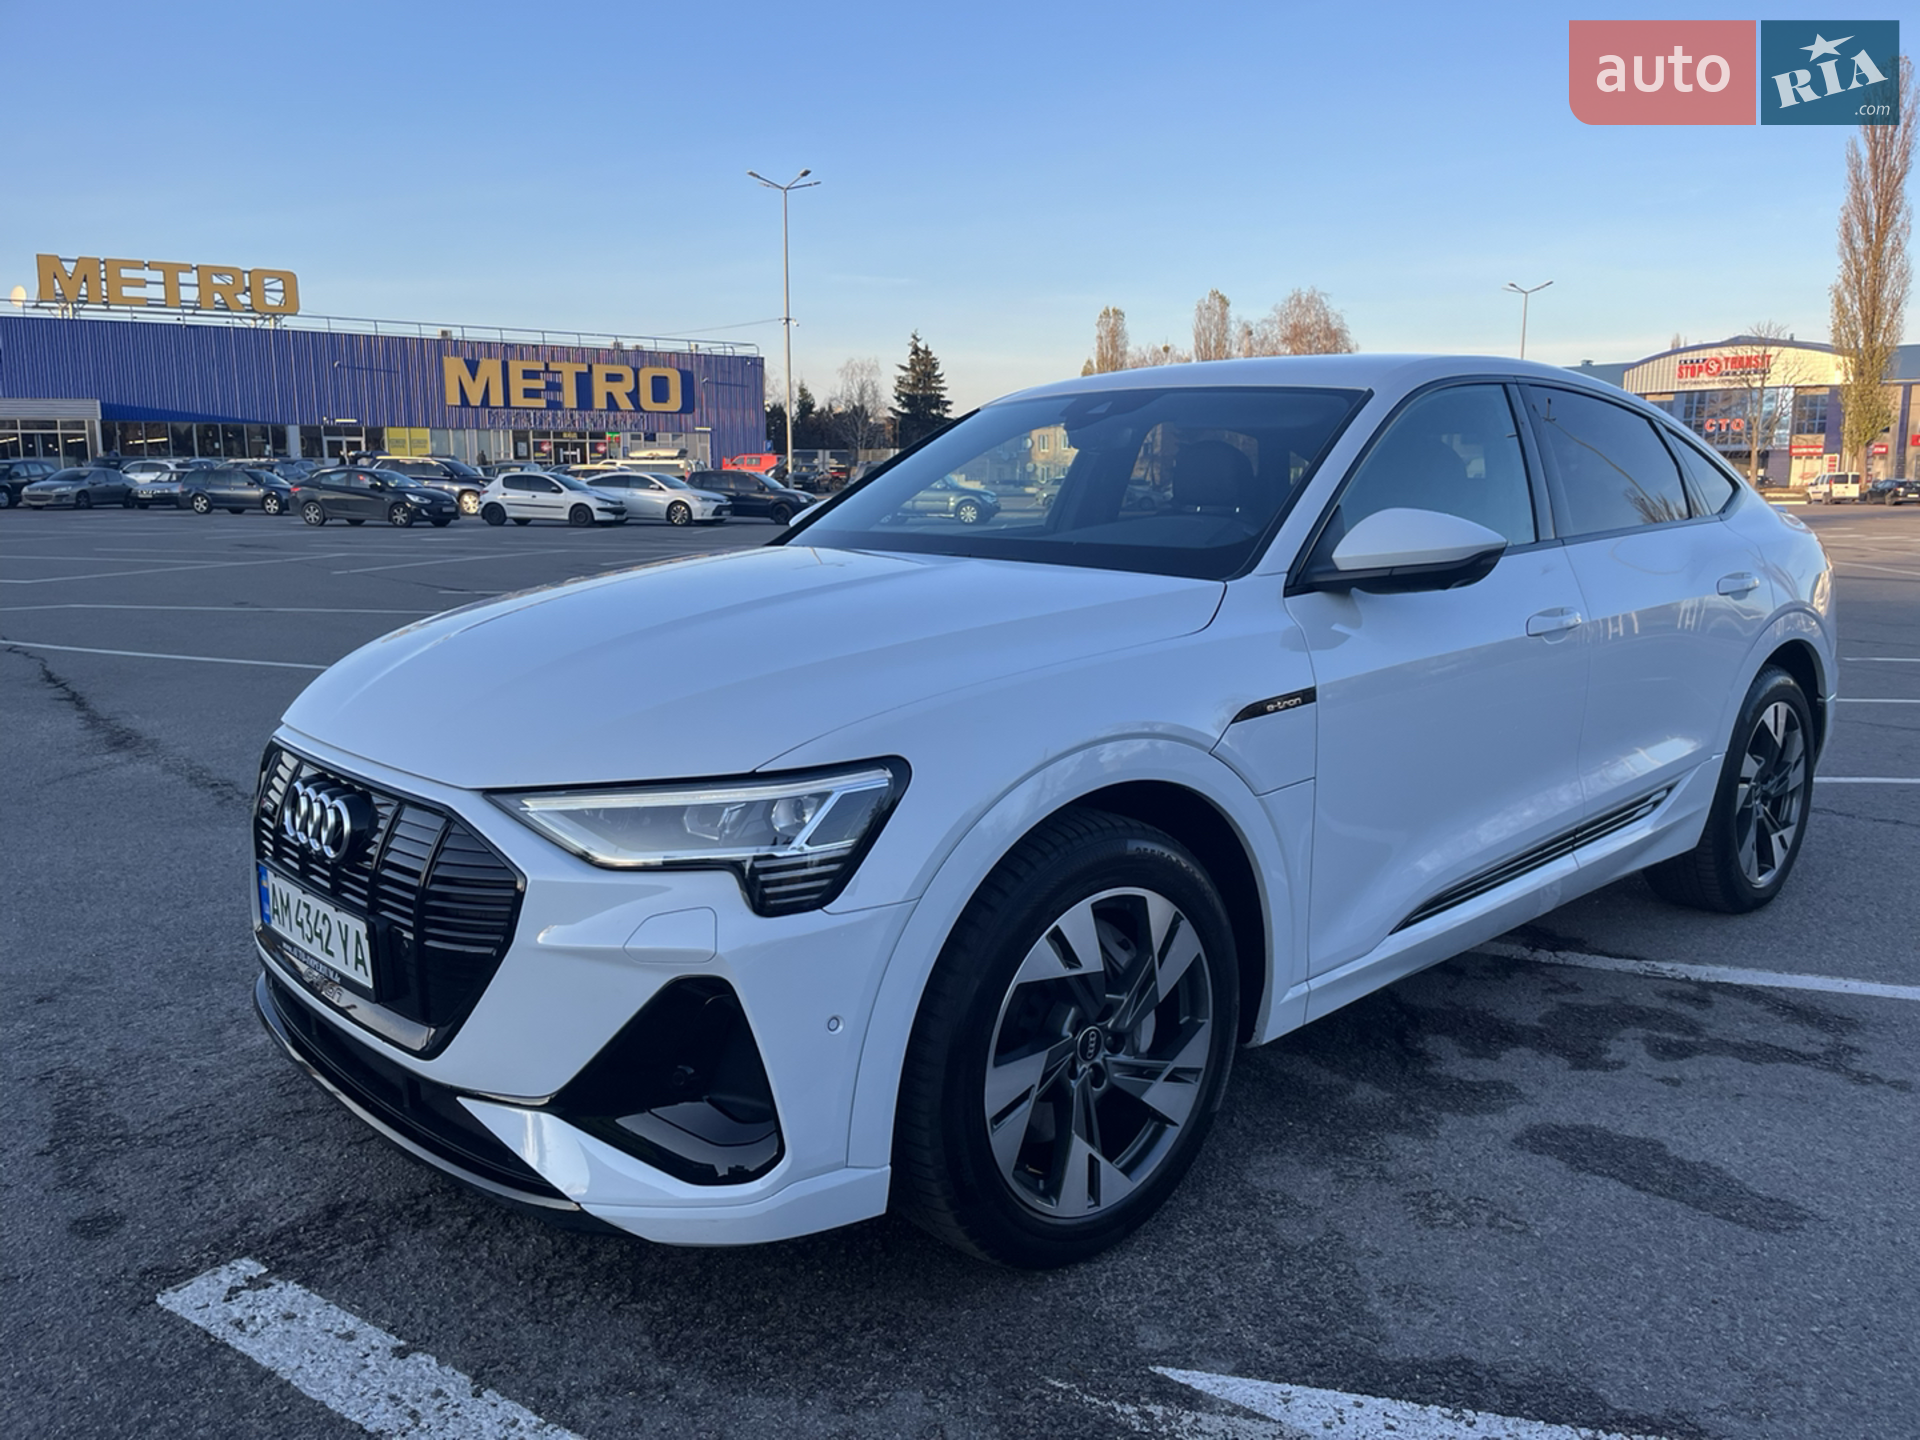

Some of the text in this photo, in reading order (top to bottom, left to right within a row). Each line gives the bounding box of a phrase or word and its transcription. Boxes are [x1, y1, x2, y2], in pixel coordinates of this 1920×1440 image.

[37, 254, 300, 315] METRO
[443, 356, 682, 412] METRO
[1677, 364, 1704, 379] STOP
[1266, 697, 1302, 712] e-tron
[271, 882, 293, 933] AM
[295, 898, 335, 958] 4342
[337, 919, 369, 978] YA
